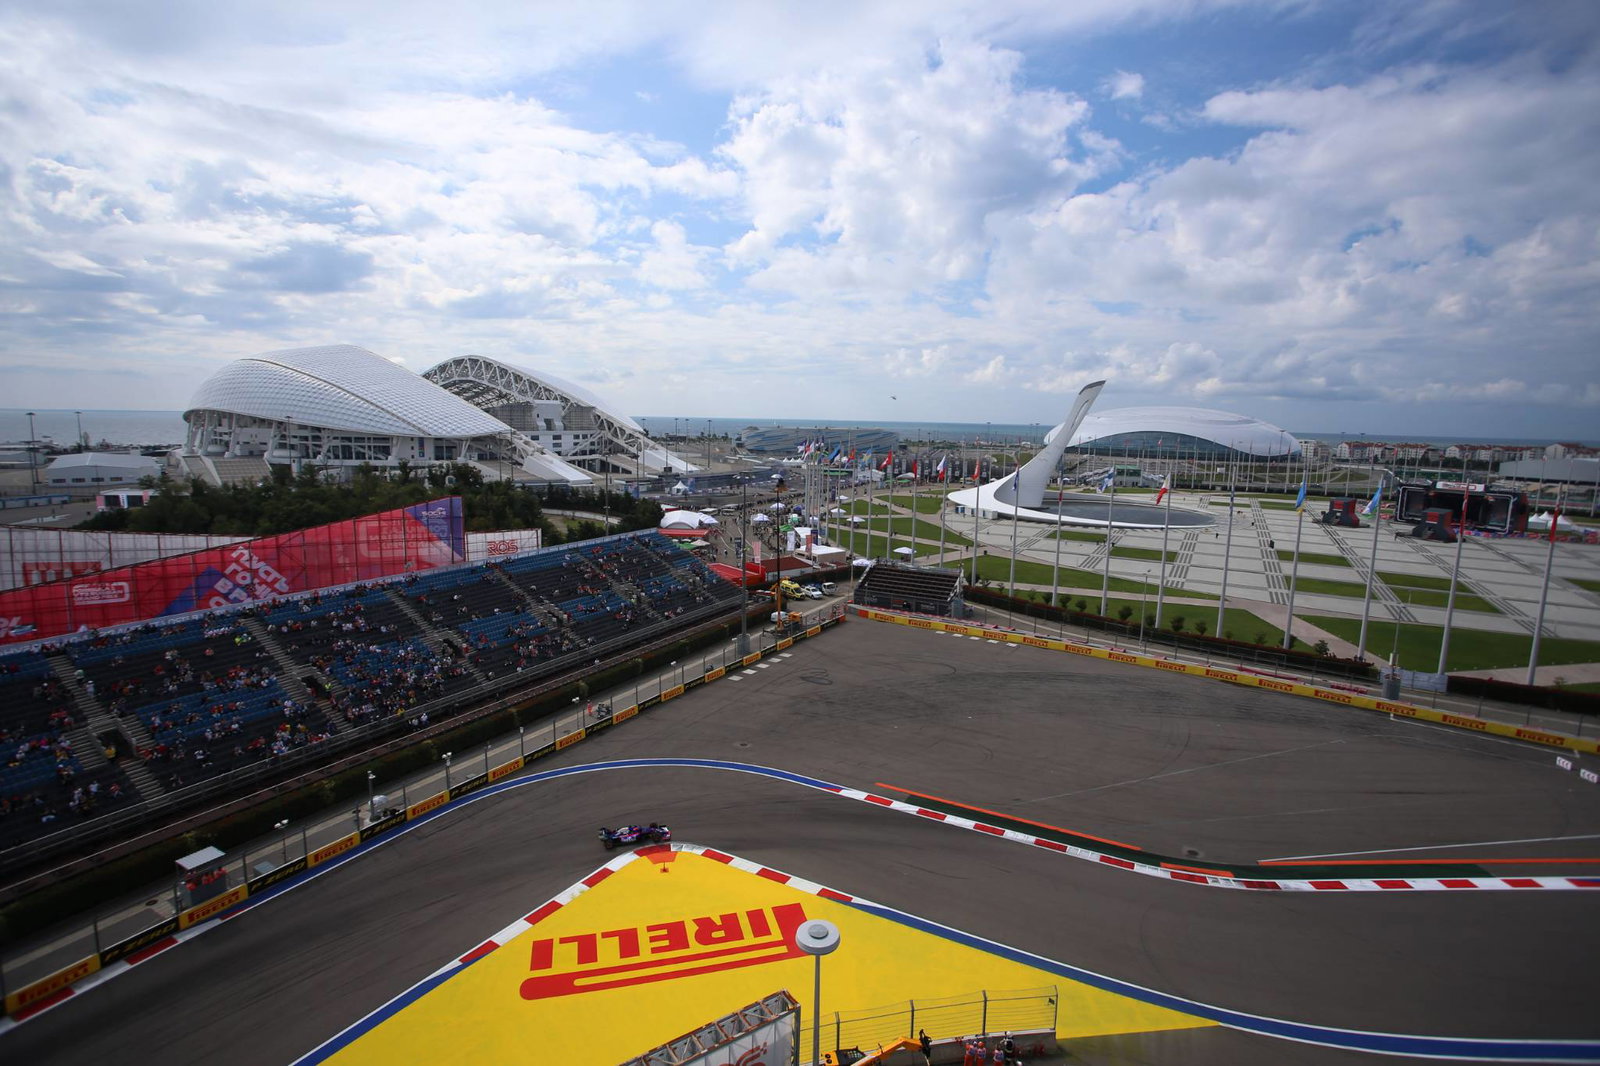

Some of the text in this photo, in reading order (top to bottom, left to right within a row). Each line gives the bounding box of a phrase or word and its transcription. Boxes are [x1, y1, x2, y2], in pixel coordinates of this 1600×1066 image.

[231, 545, 289, 593] ПУСТЬ
[1108, 652, 1137, 663] PIRELLI
[1155, 661, 1187, 672] PIRELLI
[1205, 669, 1238, 680] PIRELLI
[1258, 678, 1293, 692] PIRELLI
[1314, 690, 1352, 703] PIRELLI
[616, 705, 636, 721] PIRELLI
[1376, 702, 1416, 716] PIRELLI
[1442, 714, 1487, 730] PIRELLI
[559, 732, 583, 749] PIRELLI
[1516, 729, 1565, 746] PIRELLI
[492, 760, 520, 779] PIRELLI
[412, 795, 445, 816] PIRELLI
[314, 837, 354, 863] PIRELLI
[251, 861, 305, 892] P ZERO
[187, 890, 240, 924] PIRELLI
[519, 903, 809, 1000] PIRELLI
